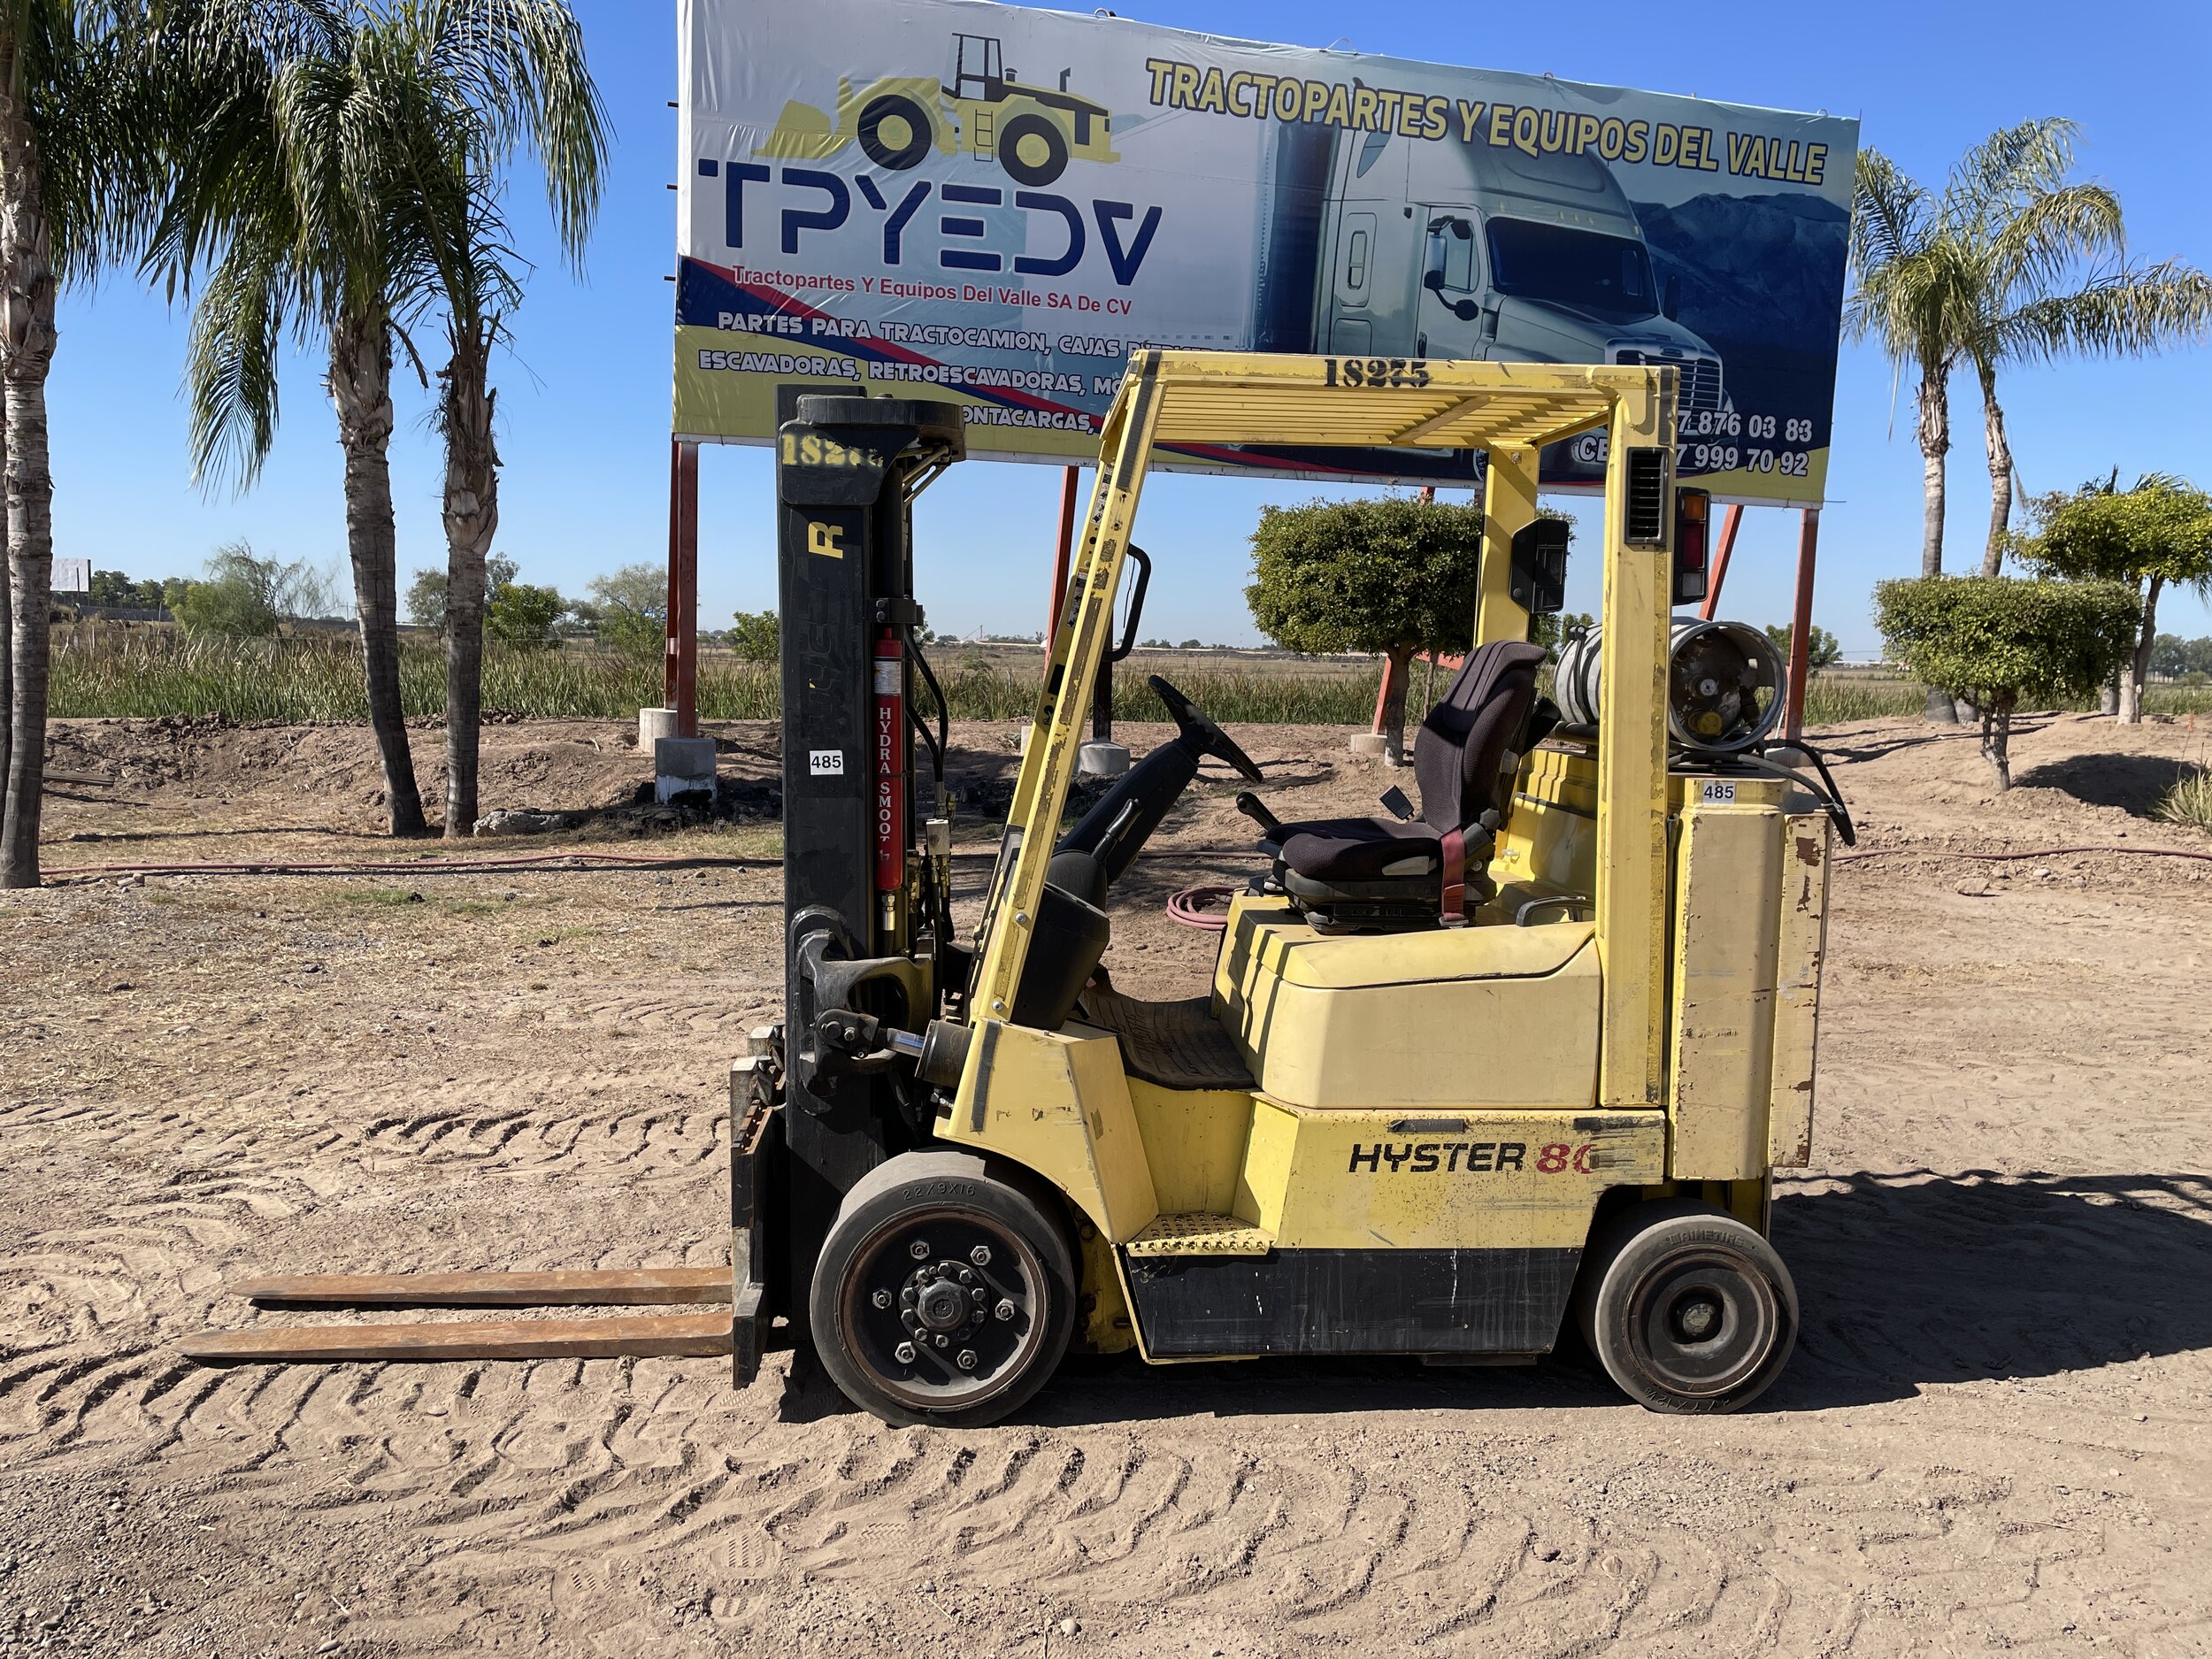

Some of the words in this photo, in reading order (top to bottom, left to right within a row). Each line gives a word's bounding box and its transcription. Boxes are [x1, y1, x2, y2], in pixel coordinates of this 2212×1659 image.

[1147, 58, 1450, 141] TRACTOPARTES
[1456, 98, 1486, 143] Y
[1487, 103, 1648, 164] EQUIPOS
[1653, 123, 1719, 173] DEL
[1726, 131, 1828, 186] VALLE
[698, 159, 1163, 286] TPYEDV
[733, 265, 855, 291] Tractopartes
[861, 276, 874, 292] Y
[880, 278, 956, 300] Equipos
[964, 285, 993, 303] Del
[998, 288, 1041, 306] Valle
[1048, 292, 1072, 309] SA
[1078, 296, 1101, 311] De
[1106, 298, 1133, 315] CV
[718, 311, 804, 334] PARTES
[811, 318, 872, 340] PARA
[880, 322, 1051, 355] TRACTOCAMION,
[1058, 335, 1120, 357] CAJAS
[699, 349, 861, 381] ESCAVADORAS,
[867, 360, 1086, 396] RETROESCAVADORAS,
[1325, 359, 1430, 388] 18275
[963, 405, 1094, 434] ONTACARGAS,
[1697, 410, 1742, 436] 876
[1748, 414, 1777, 439] 03
[1785, 418, 1813, 442] 83
[1578, 436, 1608, 463] CE
[1694, 444, 1739, 472] 999
[1747, 449, 1774, 473] 70
[1780, 451, 1809, 476] 92
[879, 708, 891, 774] HYDRA
[811, 755, 842, 769] 485
[1703, 785, 1734, 799] 485
[1348, 1143, 1526, 1172] HYSTER
